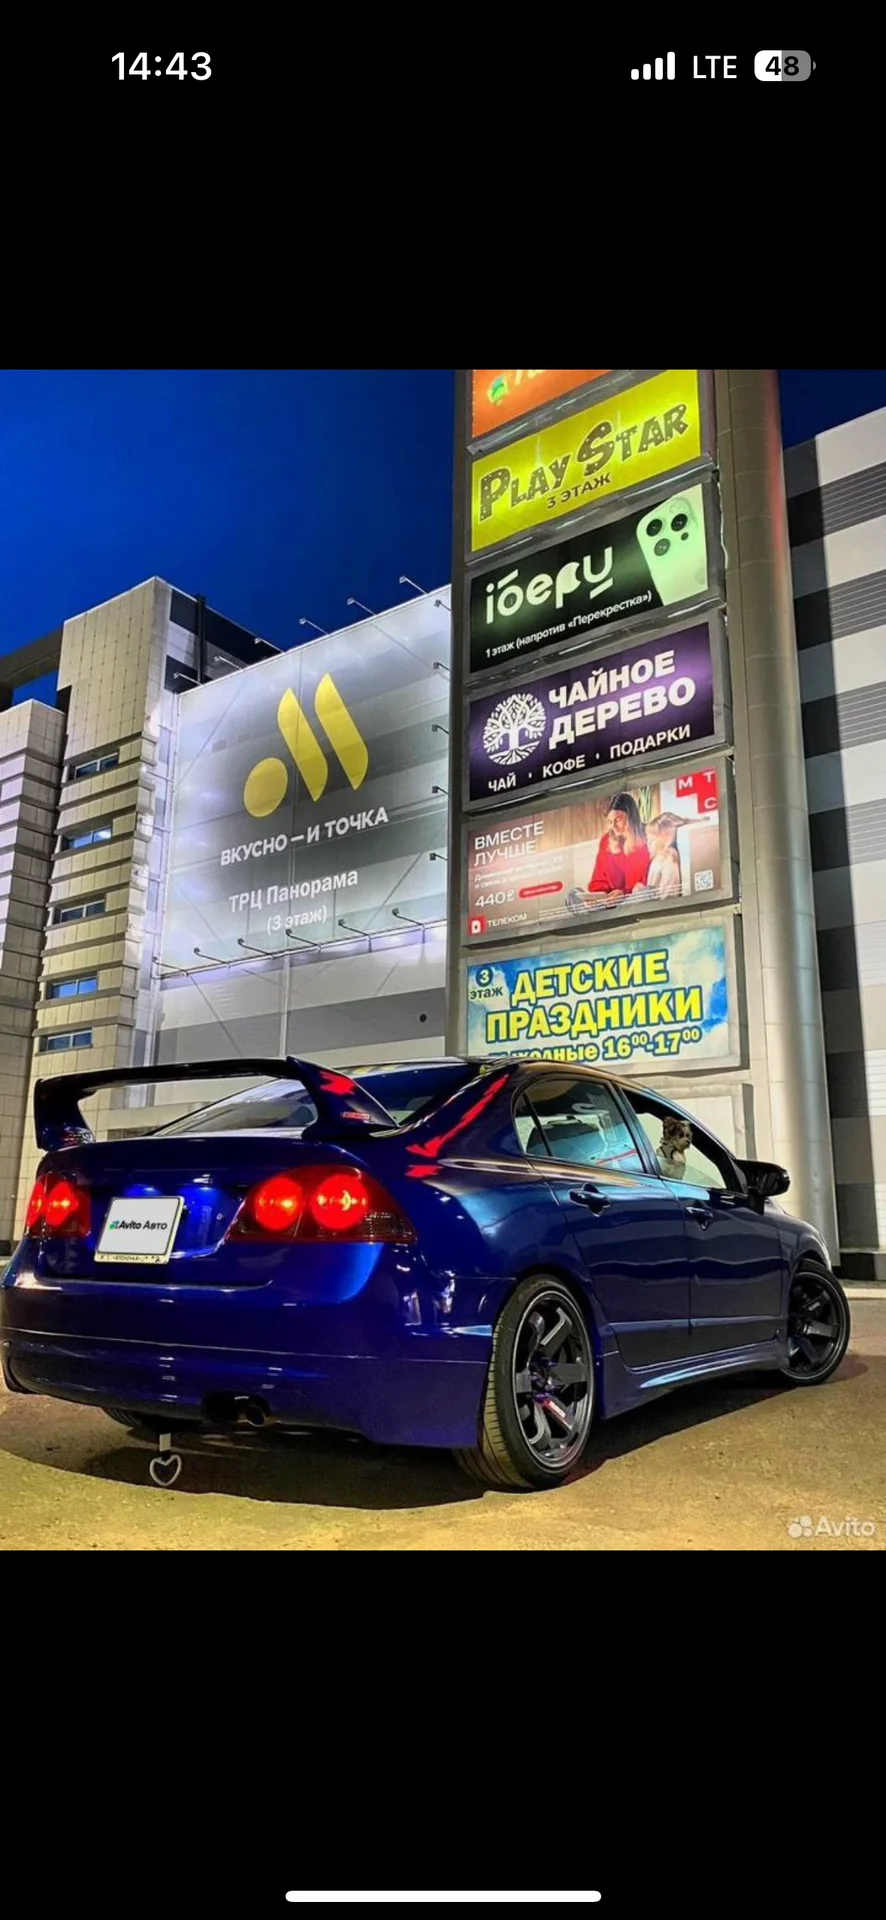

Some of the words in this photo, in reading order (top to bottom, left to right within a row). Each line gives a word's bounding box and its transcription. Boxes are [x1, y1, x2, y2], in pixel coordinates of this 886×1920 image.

[547, 496, 557, 510] 3
[560, 472, 611, 503] ЭТАЖ
[485, 648, 492, 659] 1
[491, 641, 515, 657] этаж
[516, 623, 566, 650] (напротив
[568, 590, 653, 628] «Перекрестка»)
[548, 650, 675, 709] ЧАЙНОЕ
[549, 676, 696, 750] ДЕРЕВО
[488, 772, 517, 793] ЧАЙ
[542, 754, 586, 779] КОФЕ
[610, 723, 691, 760] ПОДАРКИ
[220, 834, 288, 866] ВКУСНО
[306, 824, 320, 844] И
[325, 806, 389, 838] ТОЧКА
[473, 840, 537, 867] ЛУЧШЕ
[474, 820, 545, 850] ВМЕСТЕ
[229, 889, 262, 913] ТРЦ
[266, 870, 358, 901] Панорама
[284, 905, 327, 929] этаж)
[487, 912, 528, 928] ТЕЛЕКОМ
[470, 985, 503, 1000] этаж
[479, 970, 490, 984] 3
[510, 949, 669, 1006] ДЕТСКИЕ
[486, 986, 703, 1043] ПРАЗДНИКИ
